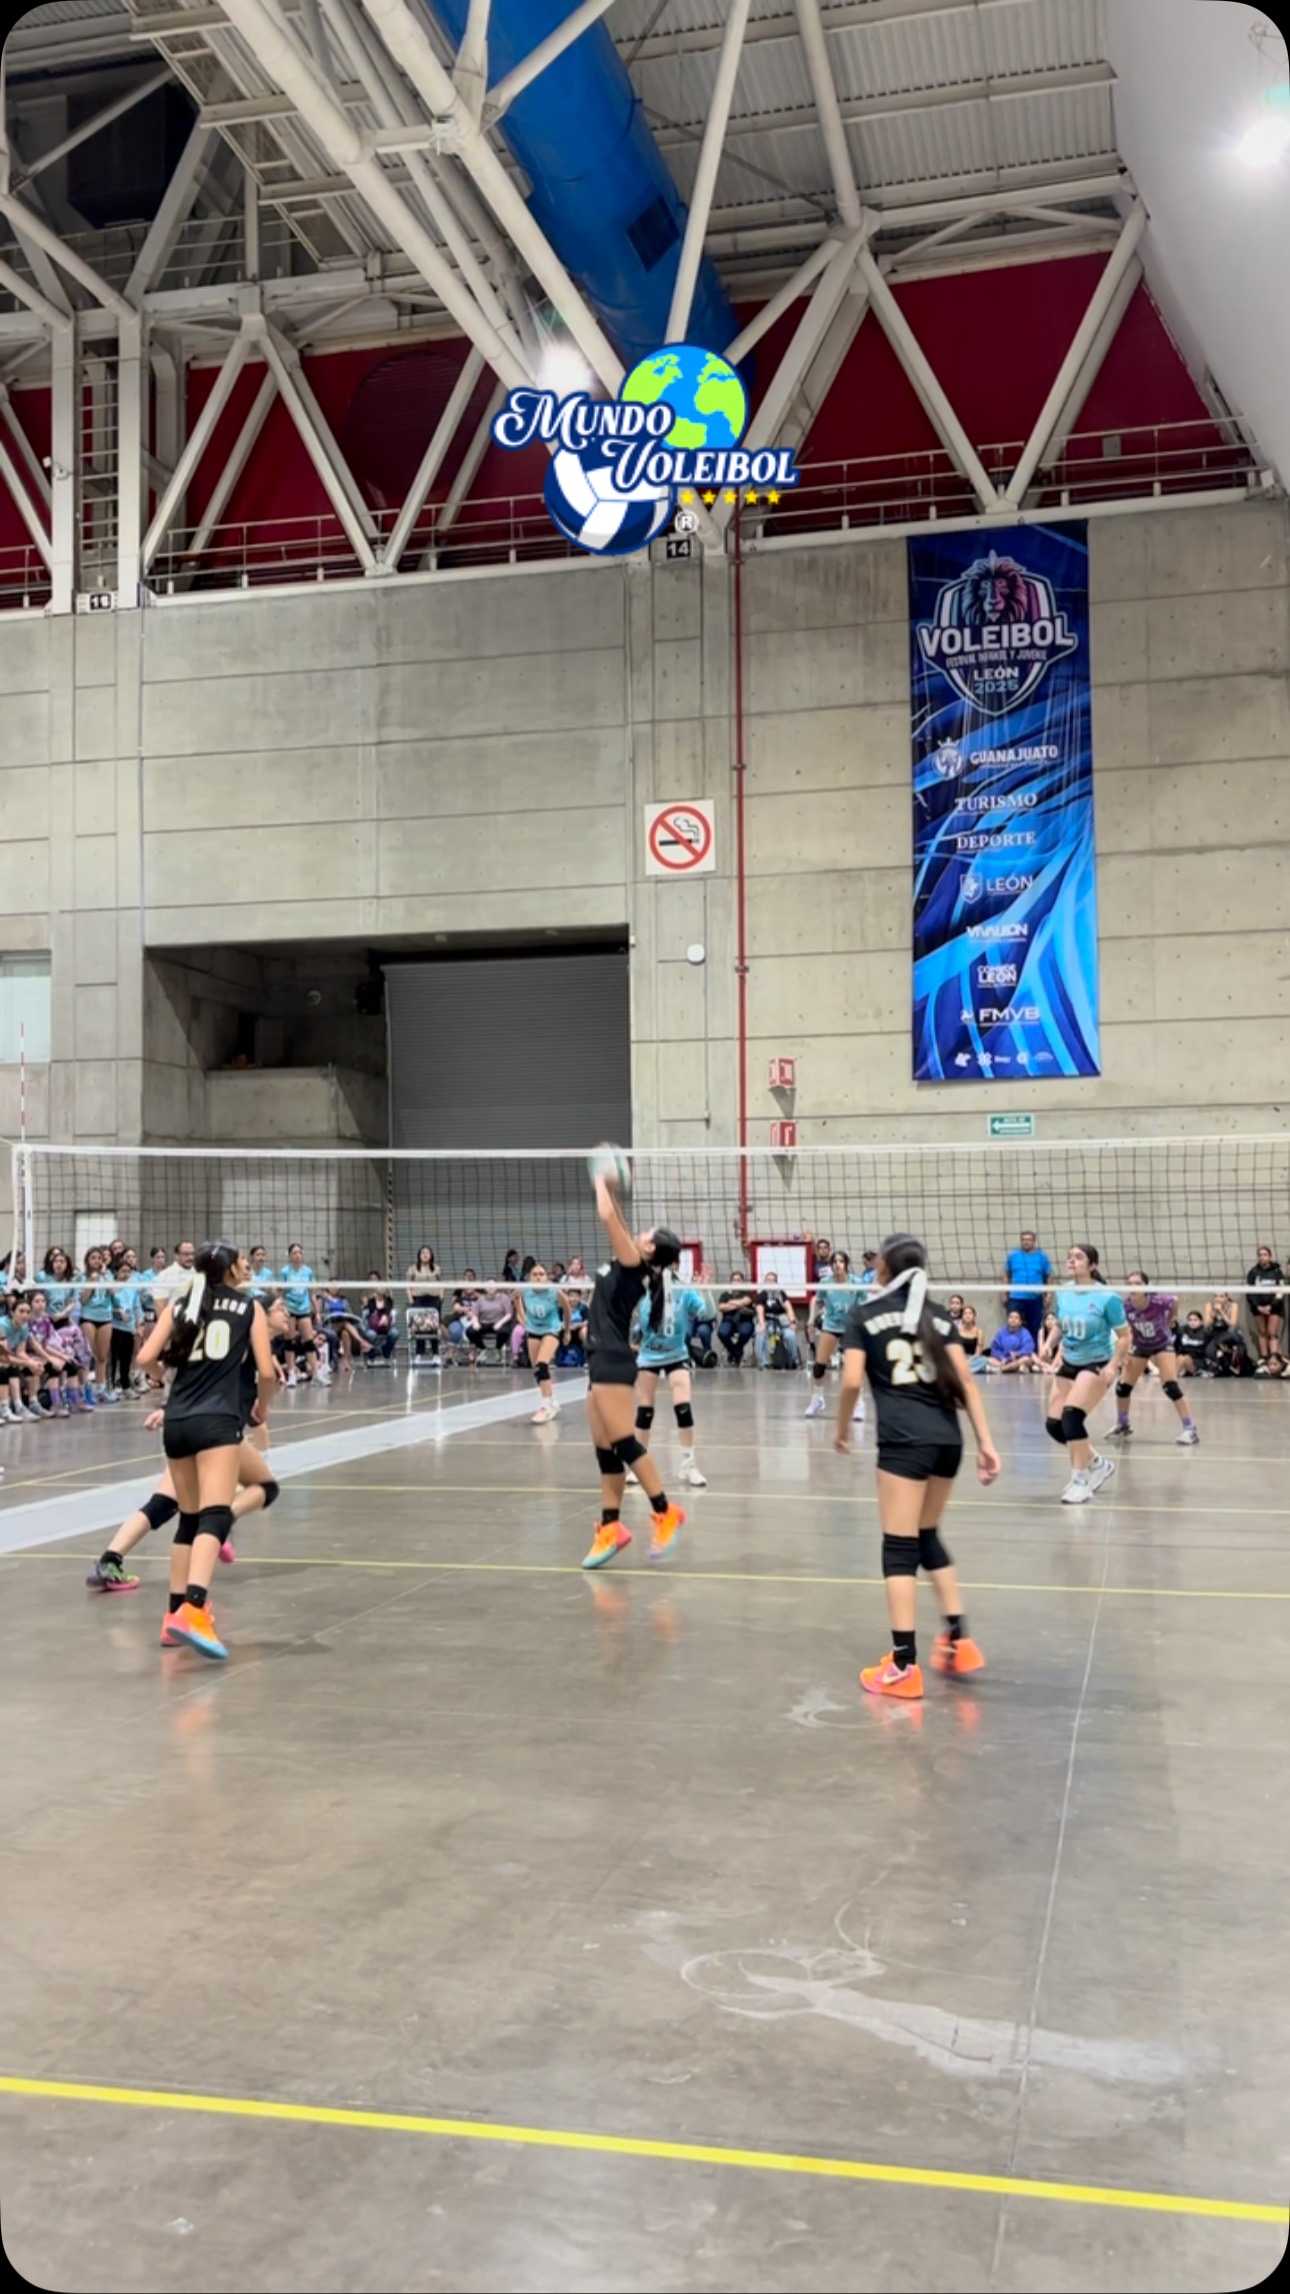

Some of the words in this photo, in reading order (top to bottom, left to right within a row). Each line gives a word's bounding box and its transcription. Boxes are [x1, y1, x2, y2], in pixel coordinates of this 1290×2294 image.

[667, 541, 690, 557] 14
[921, 617, 1074, 657] VOLEIBOL
[945, 653, 977, 669] FESTIVAL
[978, 649, 1008, 662] INFANTIL
[1009, 649, 1016, 659] Y
[1017, 649, 1048, 661] JUVENIL
[973, 665, 1019, 681] LEÓN
[973, 679, 1019, 694] 2025
[969, 745, 1059, 765] GUANAJUATO
[955, 793, 1037, 811] TURISMO
[956, 831, 1036, 850] DEPORTE
[986, 873, 1034, 891] LEÓN
[979, 1007, 1040, 1022] FMVB
[213, 1298, 248, 1316] LEON
